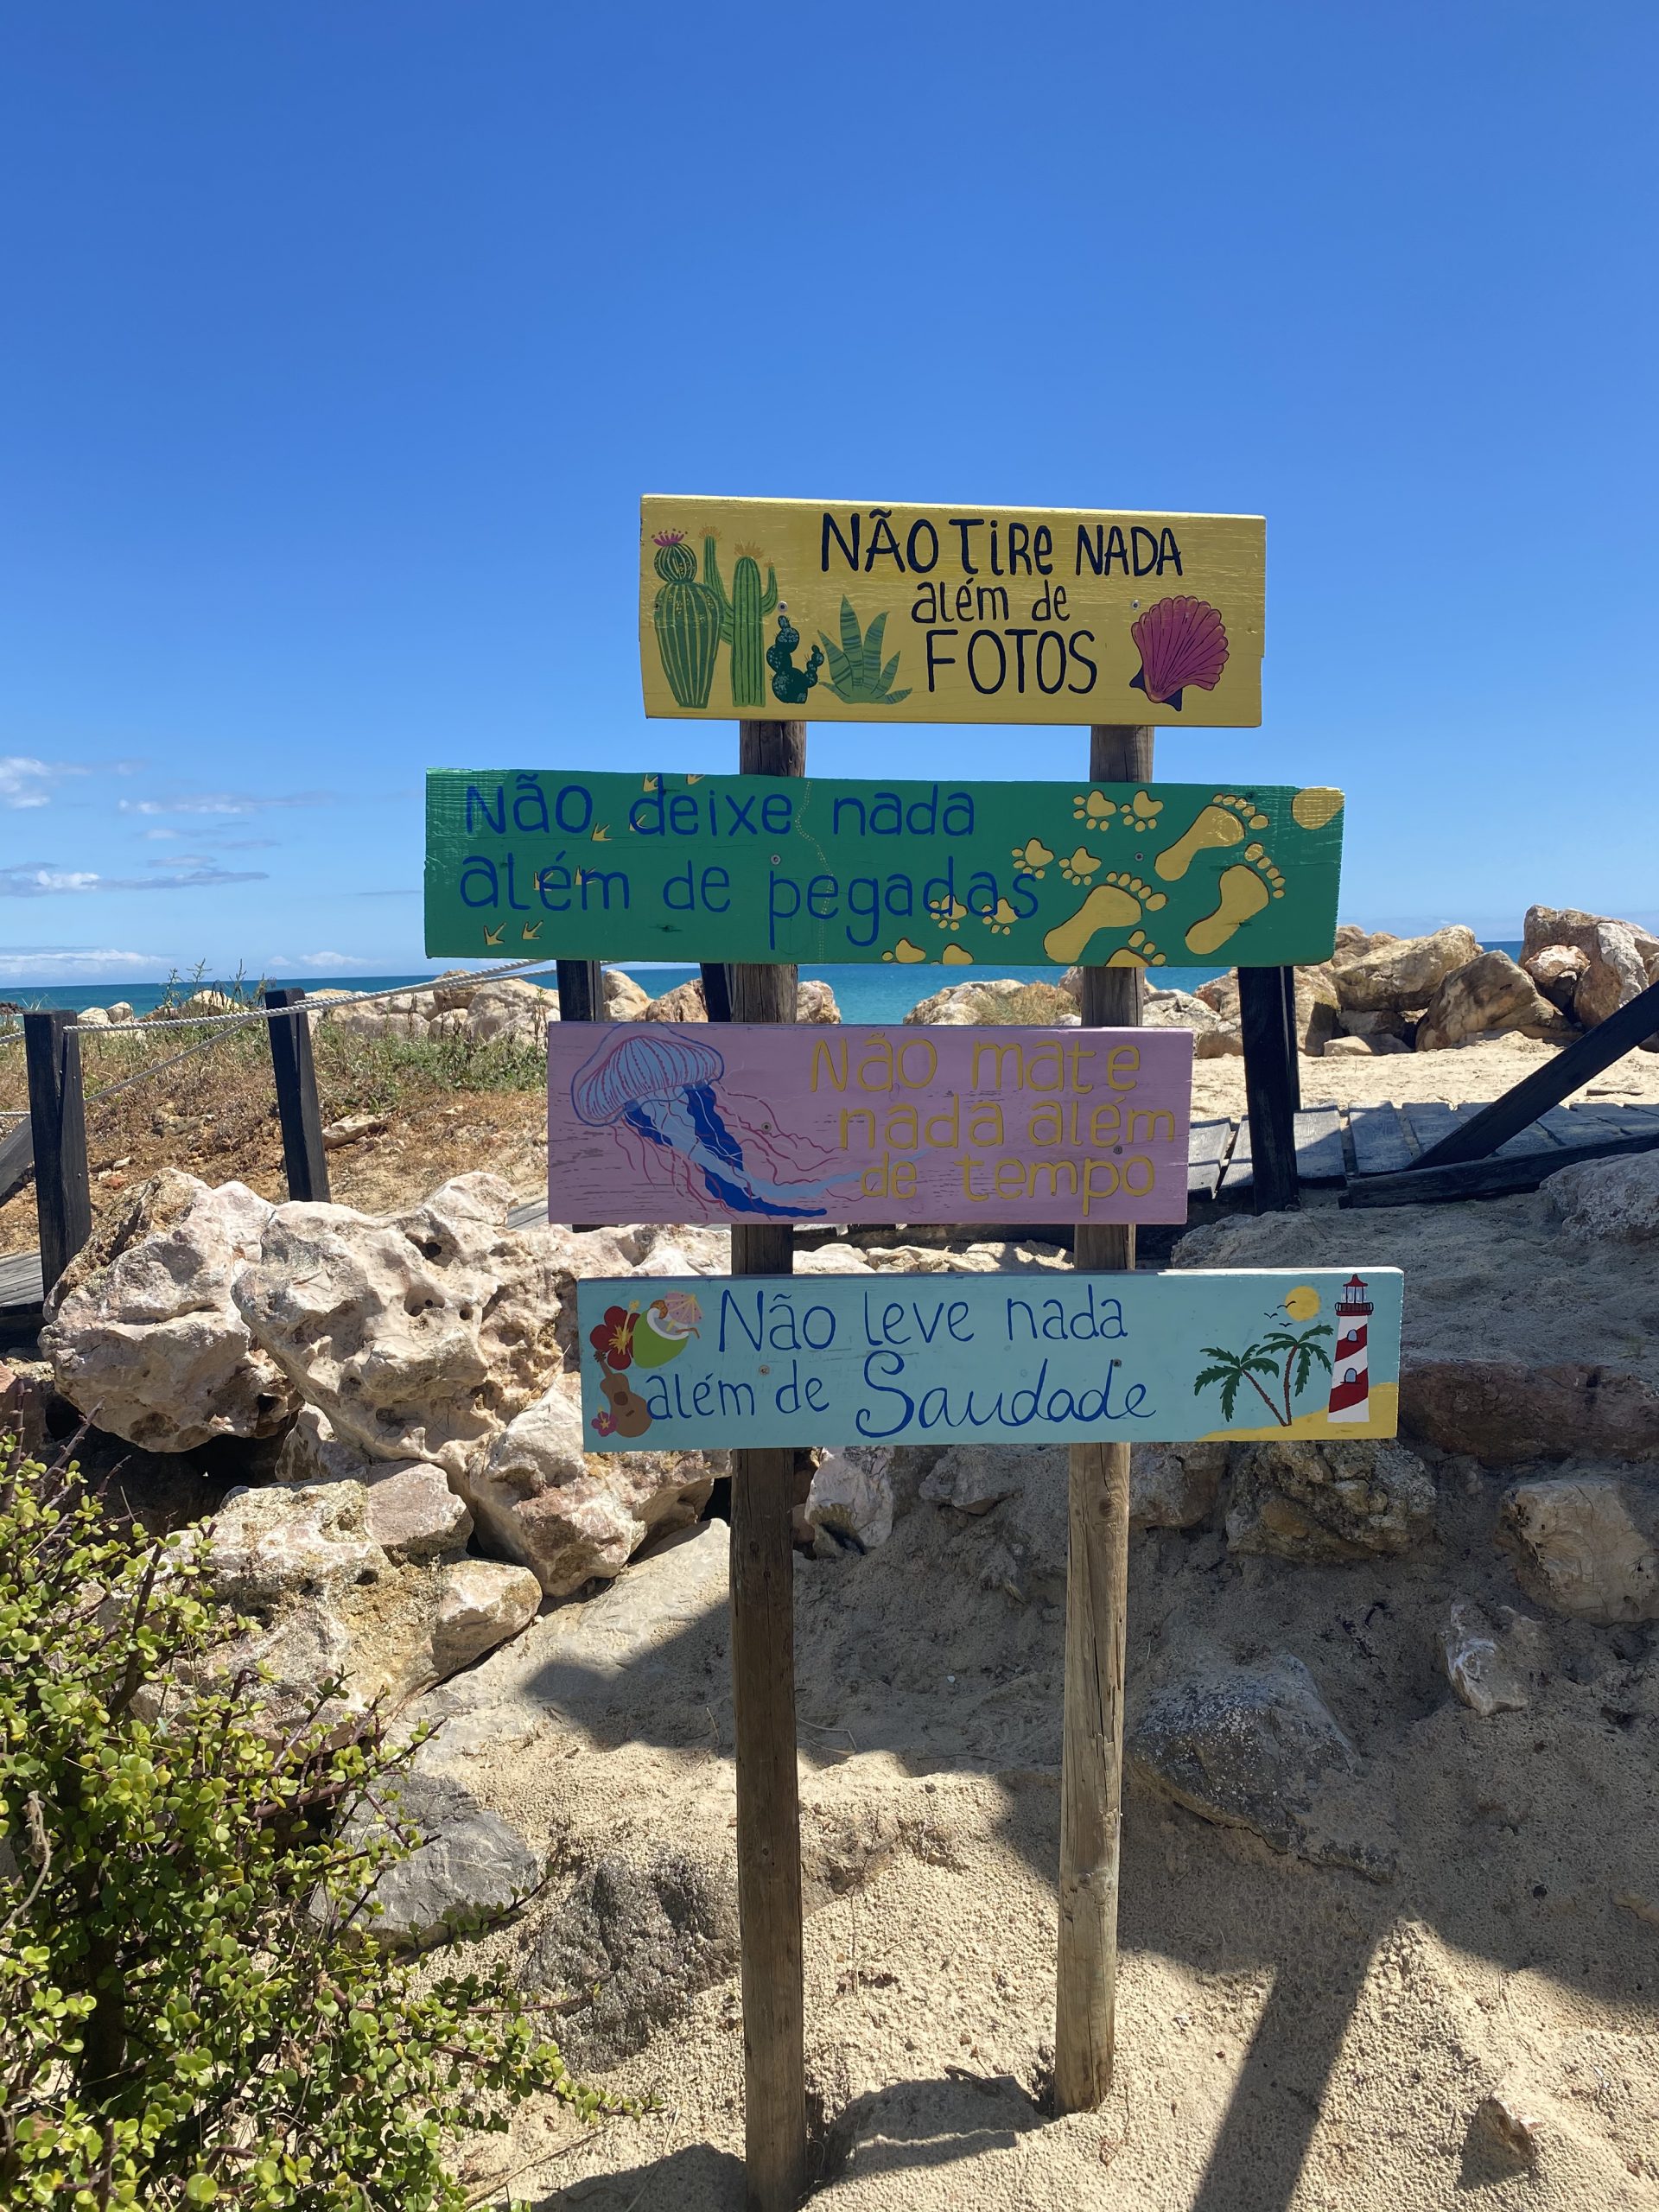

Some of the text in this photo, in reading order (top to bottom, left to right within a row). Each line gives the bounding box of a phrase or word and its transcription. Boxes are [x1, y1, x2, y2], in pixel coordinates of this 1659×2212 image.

[822, 508, 938, 576] NÃO
[1076, 524, 1182, 576] NADA
[912, 578, 1070, 623] além de
[925, 629, 1096, 695] FOTOS
[466, 772, 975, 837] Não deixe nada
[460, 851, 1038, 950] além de pegadas
[810, 1033, 1141, 1094] Não mate
[840, 1092, 1175, 1150] nada além
[863, 1153, 1155, 1216] de tempo
[718, 1284, 1128, 1352] Não leve nada
[646, 1350, 1157, 1437] além de Saudade
